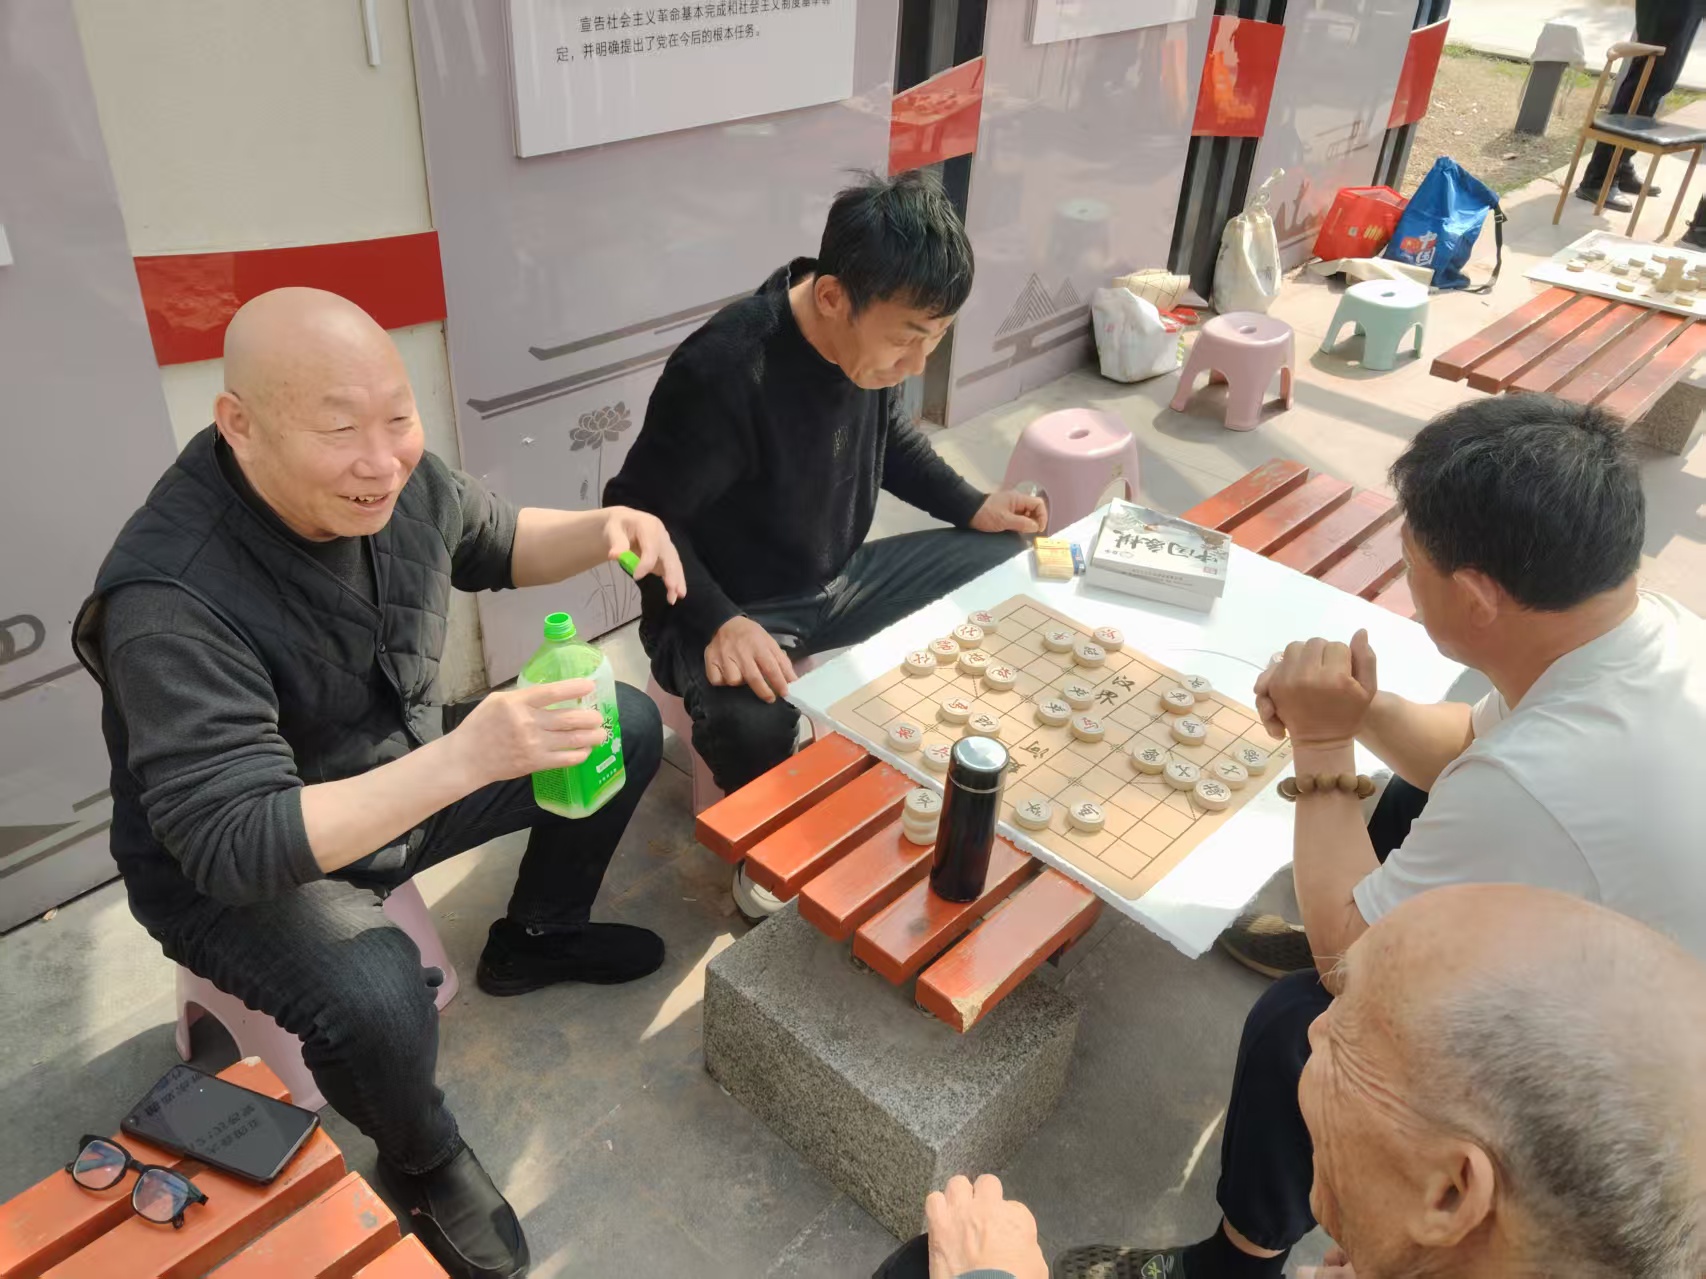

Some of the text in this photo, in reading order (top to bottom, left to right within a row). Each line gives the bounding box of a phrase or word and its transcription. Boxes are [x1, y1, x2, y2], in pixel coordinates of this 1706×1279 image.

[556, 24, 760, 63] 定，并明确提出了党在今后的根本任务。
